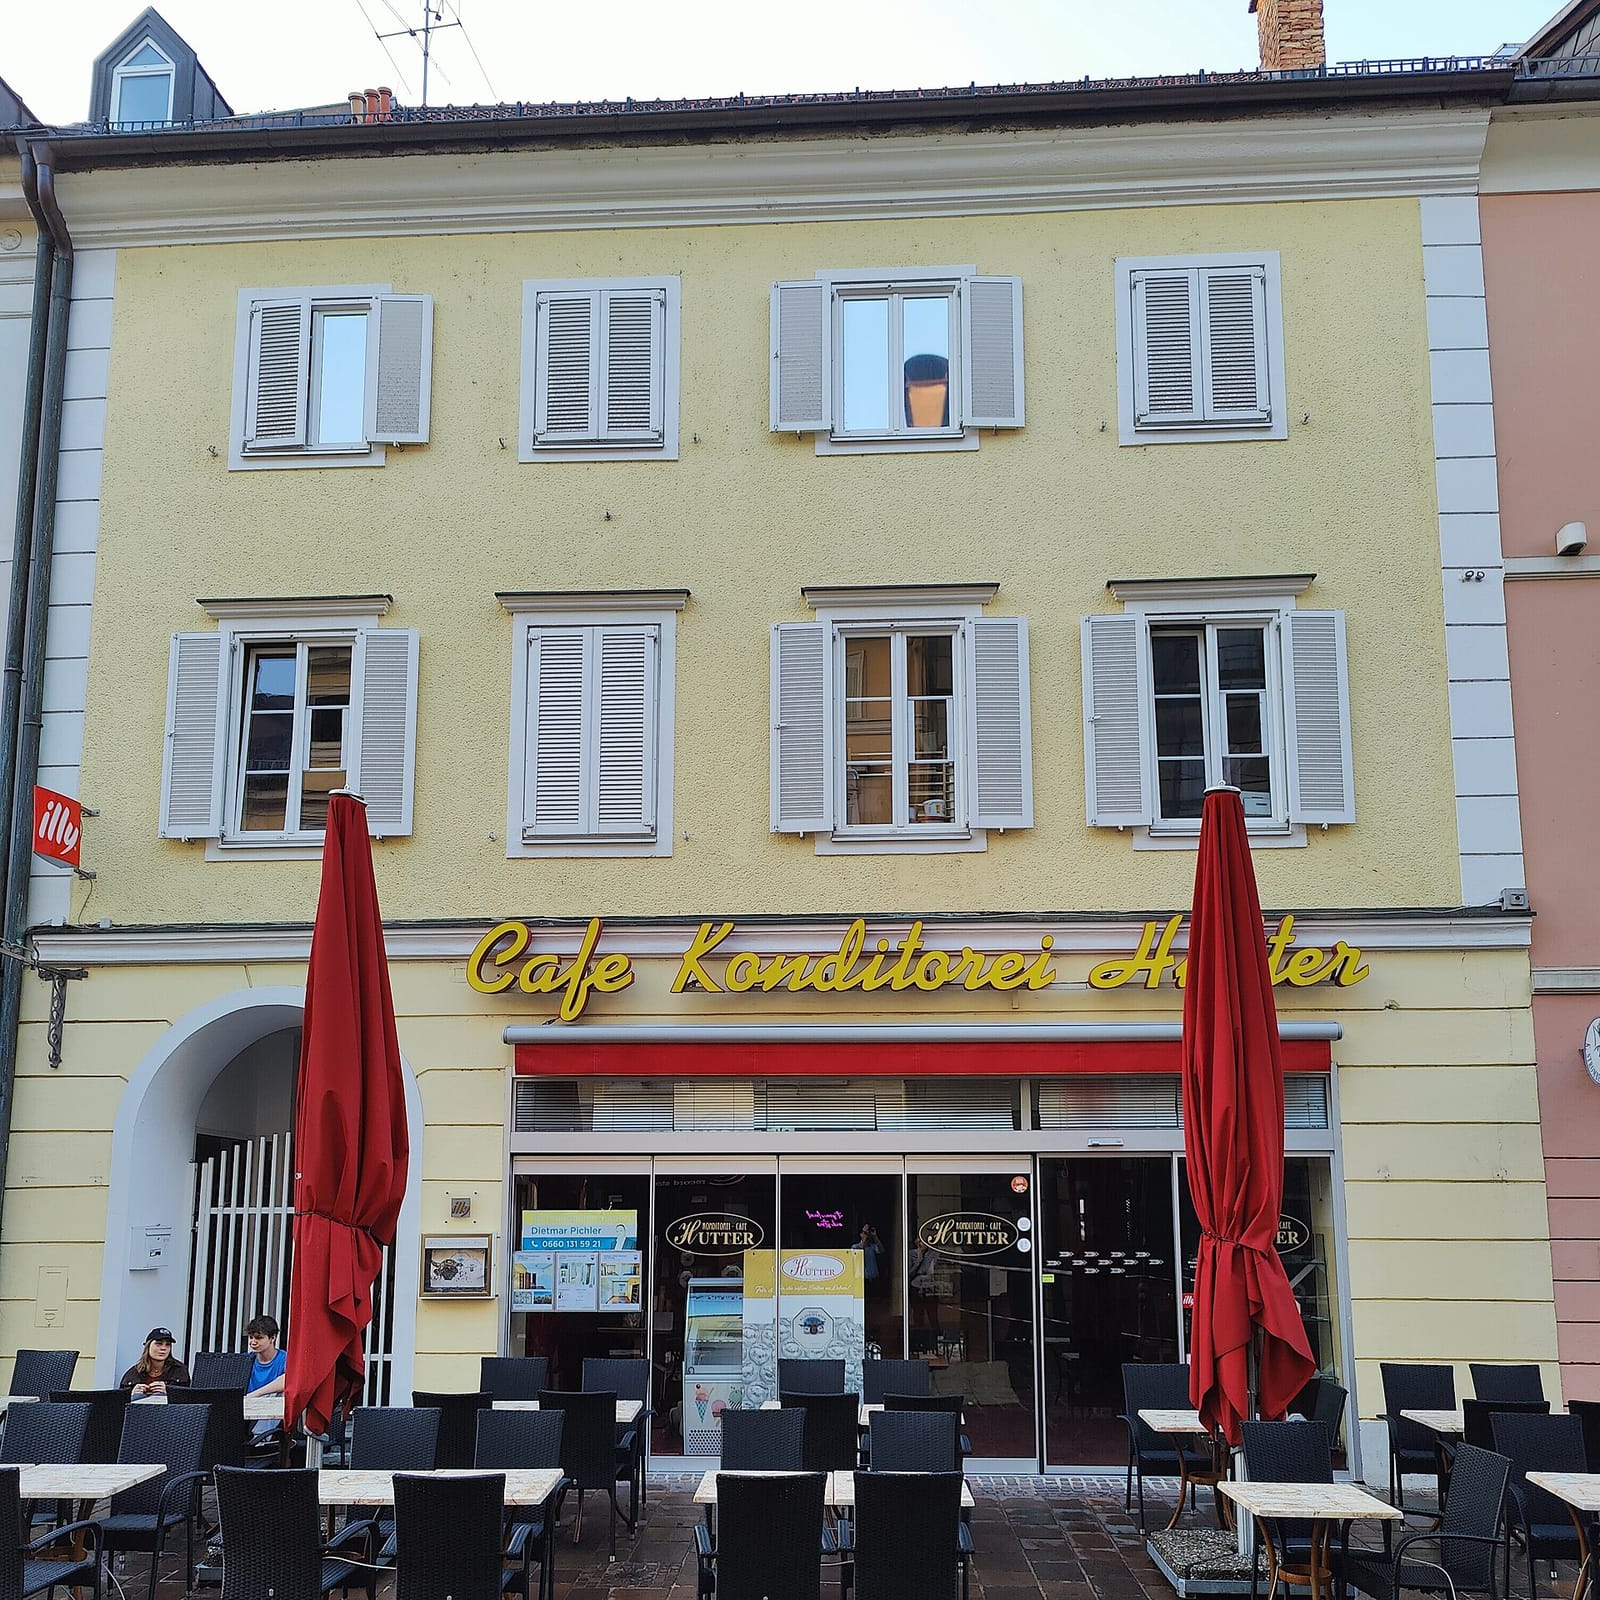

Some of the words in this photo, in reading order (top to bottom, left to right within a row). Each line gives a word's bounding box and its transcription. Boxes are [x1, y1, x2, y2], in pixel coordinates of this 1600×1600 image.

[38, 800, 79, 855] illy
[466, 917, 635, 1022] Cafe
[670, 917, 1056, 994] Konditorei
[1089, 913, 1370, 989] Hter
[531, 1227, 568, 1235] Dietmar
[570, 1227, 602, 1235] Pichler
[542, 1240, 563, 1248] 0660
[566, 1240, 578, 1248] 131
[580, 1240, 591, 1248] 59
[592, 1240, 601, 1248] 21
[674, 1219, 755, 1245] HUTTER
[927, 1219, 1009, 1245] HUTTER
[790, 1258, 835, 1277] HUTTER
